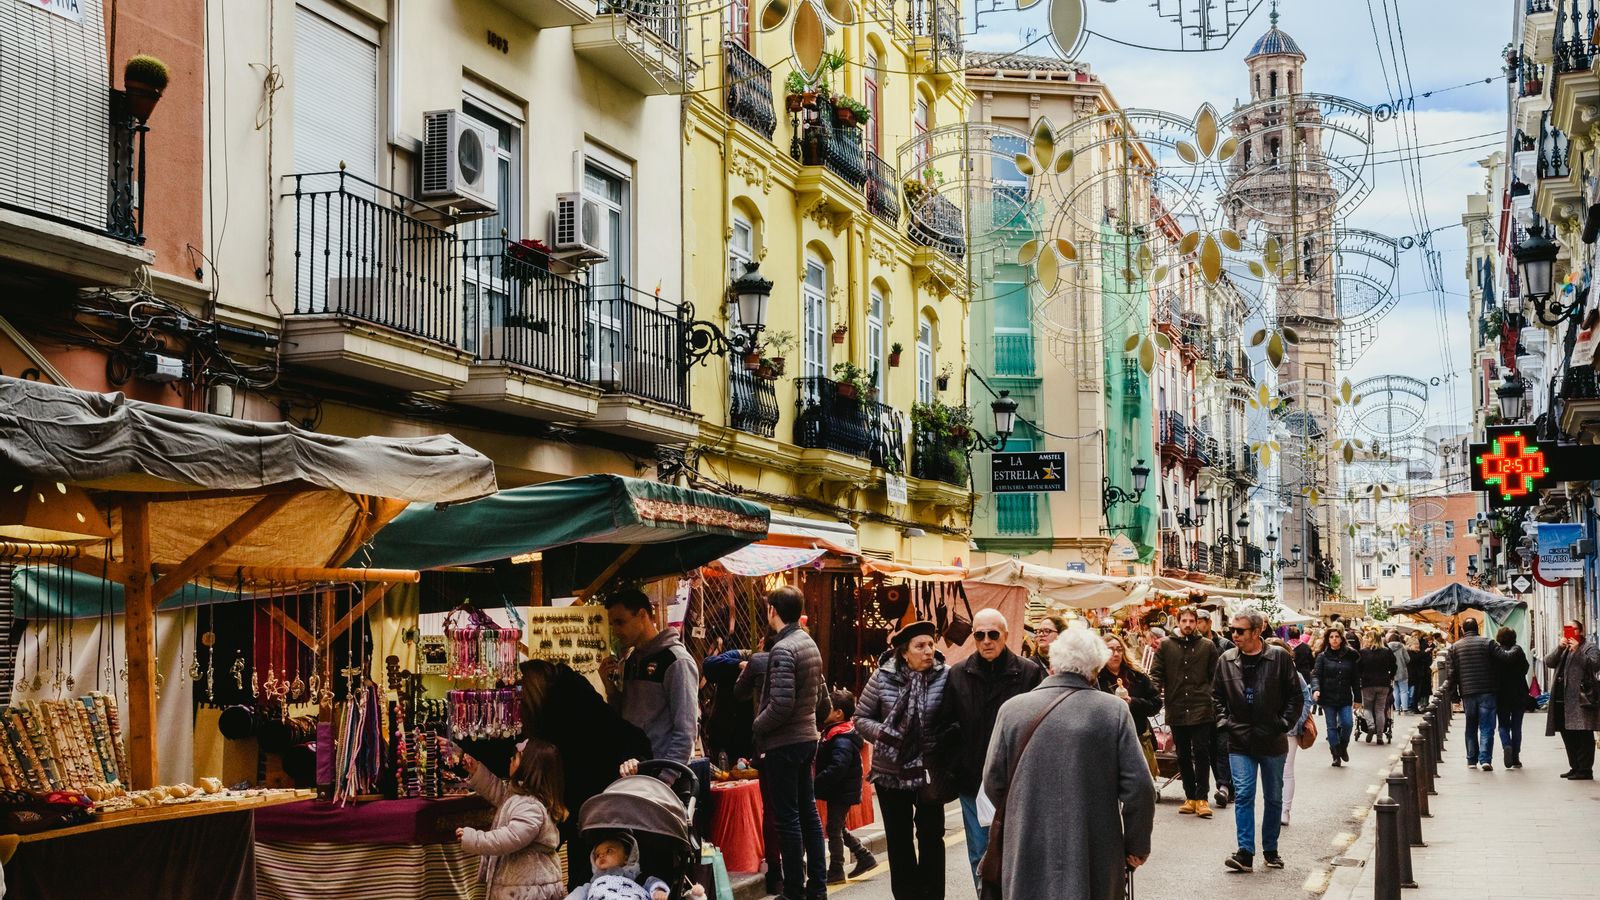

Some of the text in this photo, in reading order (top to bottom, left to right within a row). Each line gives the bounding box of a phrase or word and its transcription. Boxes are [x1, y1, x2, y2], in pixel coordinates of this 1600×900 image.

[1010, 456, 1023, 466] LA
[1499, 459, 1532, 472] 12:51
[994, 470, 1040, 480] ESTRELLA
